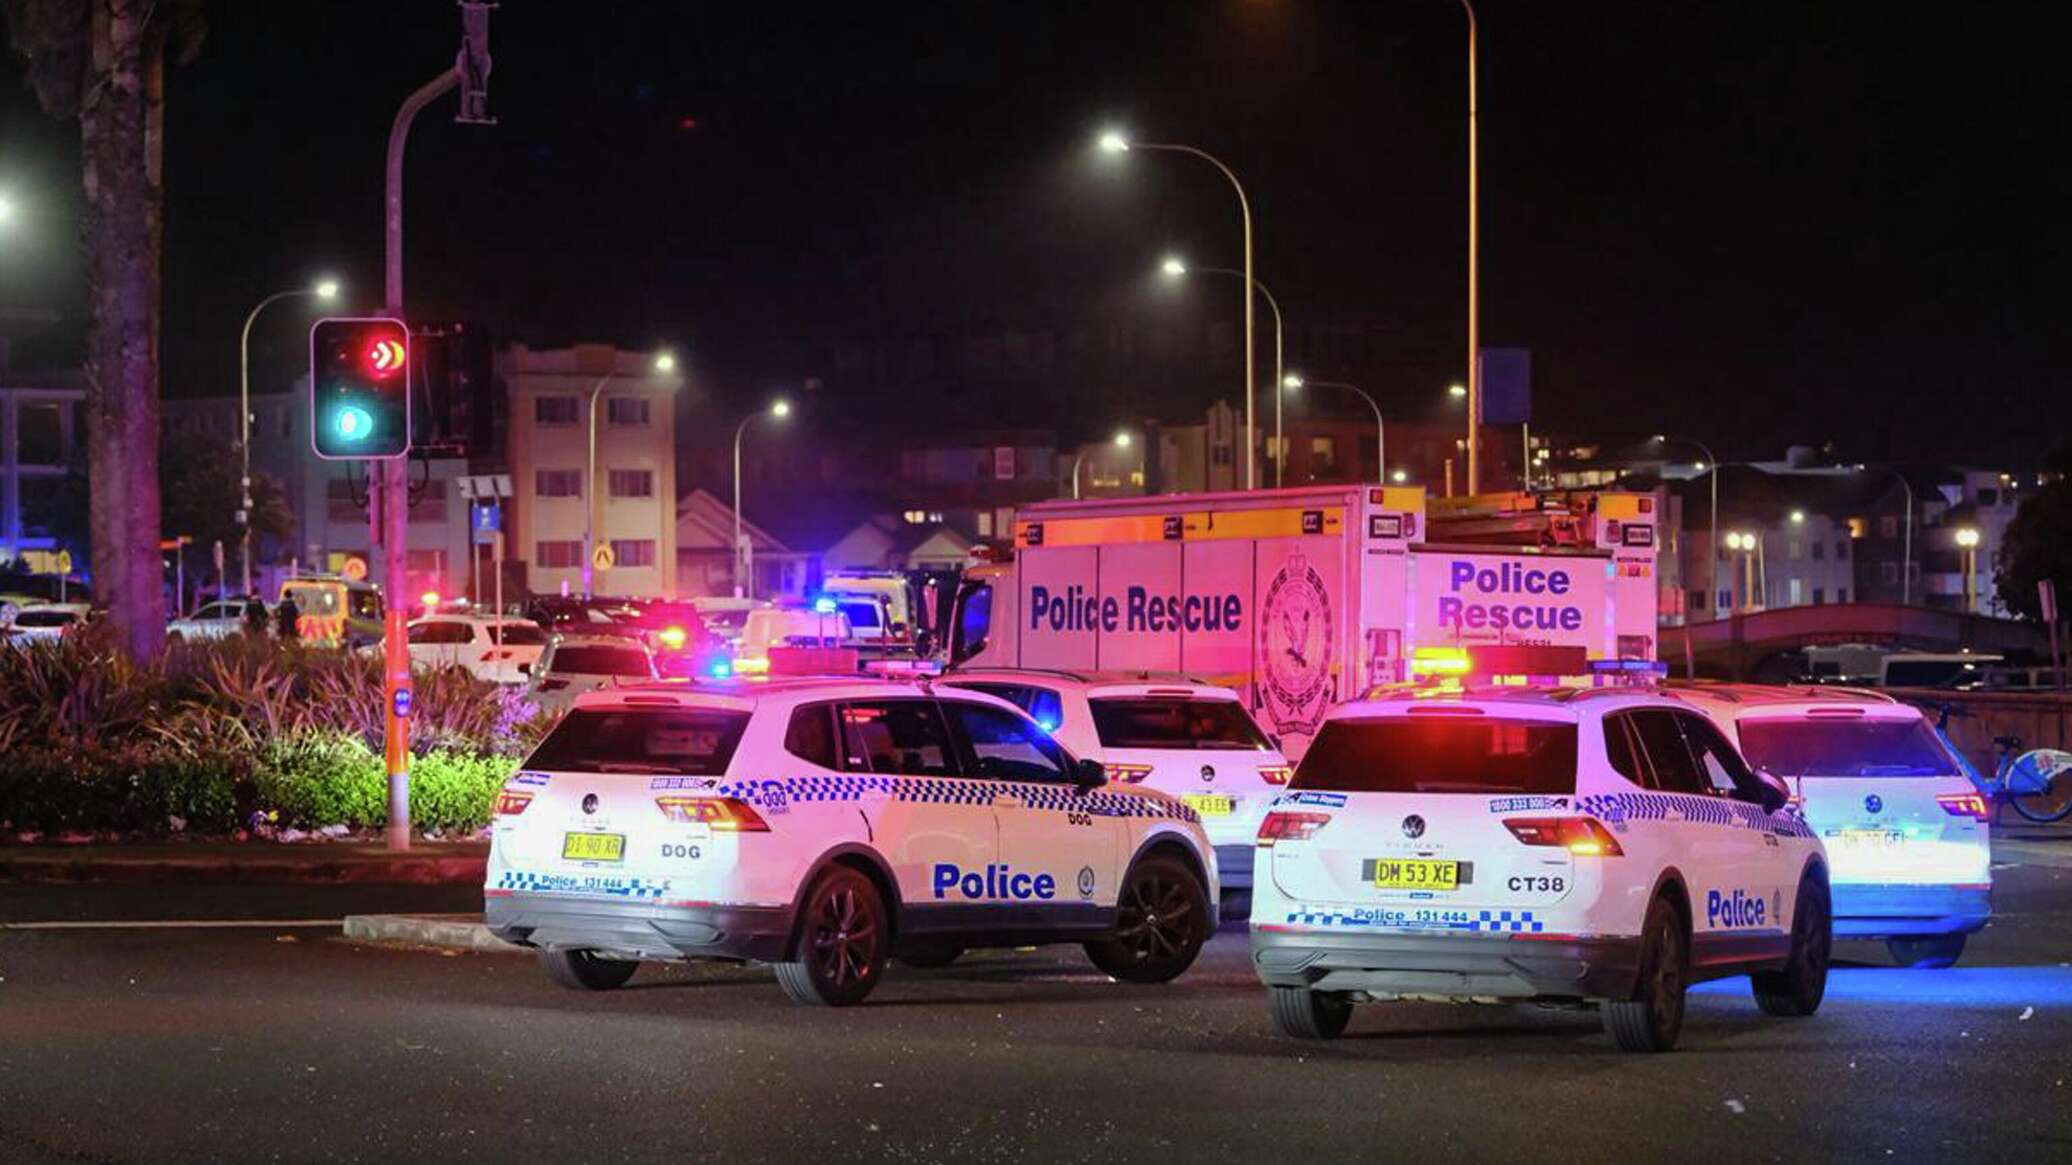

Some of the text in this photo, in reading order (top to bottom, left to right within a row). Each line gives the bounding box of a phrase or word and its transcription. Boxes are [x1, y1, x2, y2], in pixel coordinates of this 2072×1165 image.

[1451, 561, 1570, 594] Police
[1031, 585, 1243, 632] Police Rescue
[1438, 596, 1582, 630] Rescue
[1068, 813, 1092, 826] DOG
[661, 844, 701, 859] DOG
[542, 875, 577, 887] Police
[934, 864, 1056, 899] Police
[1379, 862, 1454, 883] DM 53 XE
[1507, 877, 1564, 893] CT38
[1354, 908, 1468, 922] Police 131 444
[1708, 889, 1766, 928] Police
